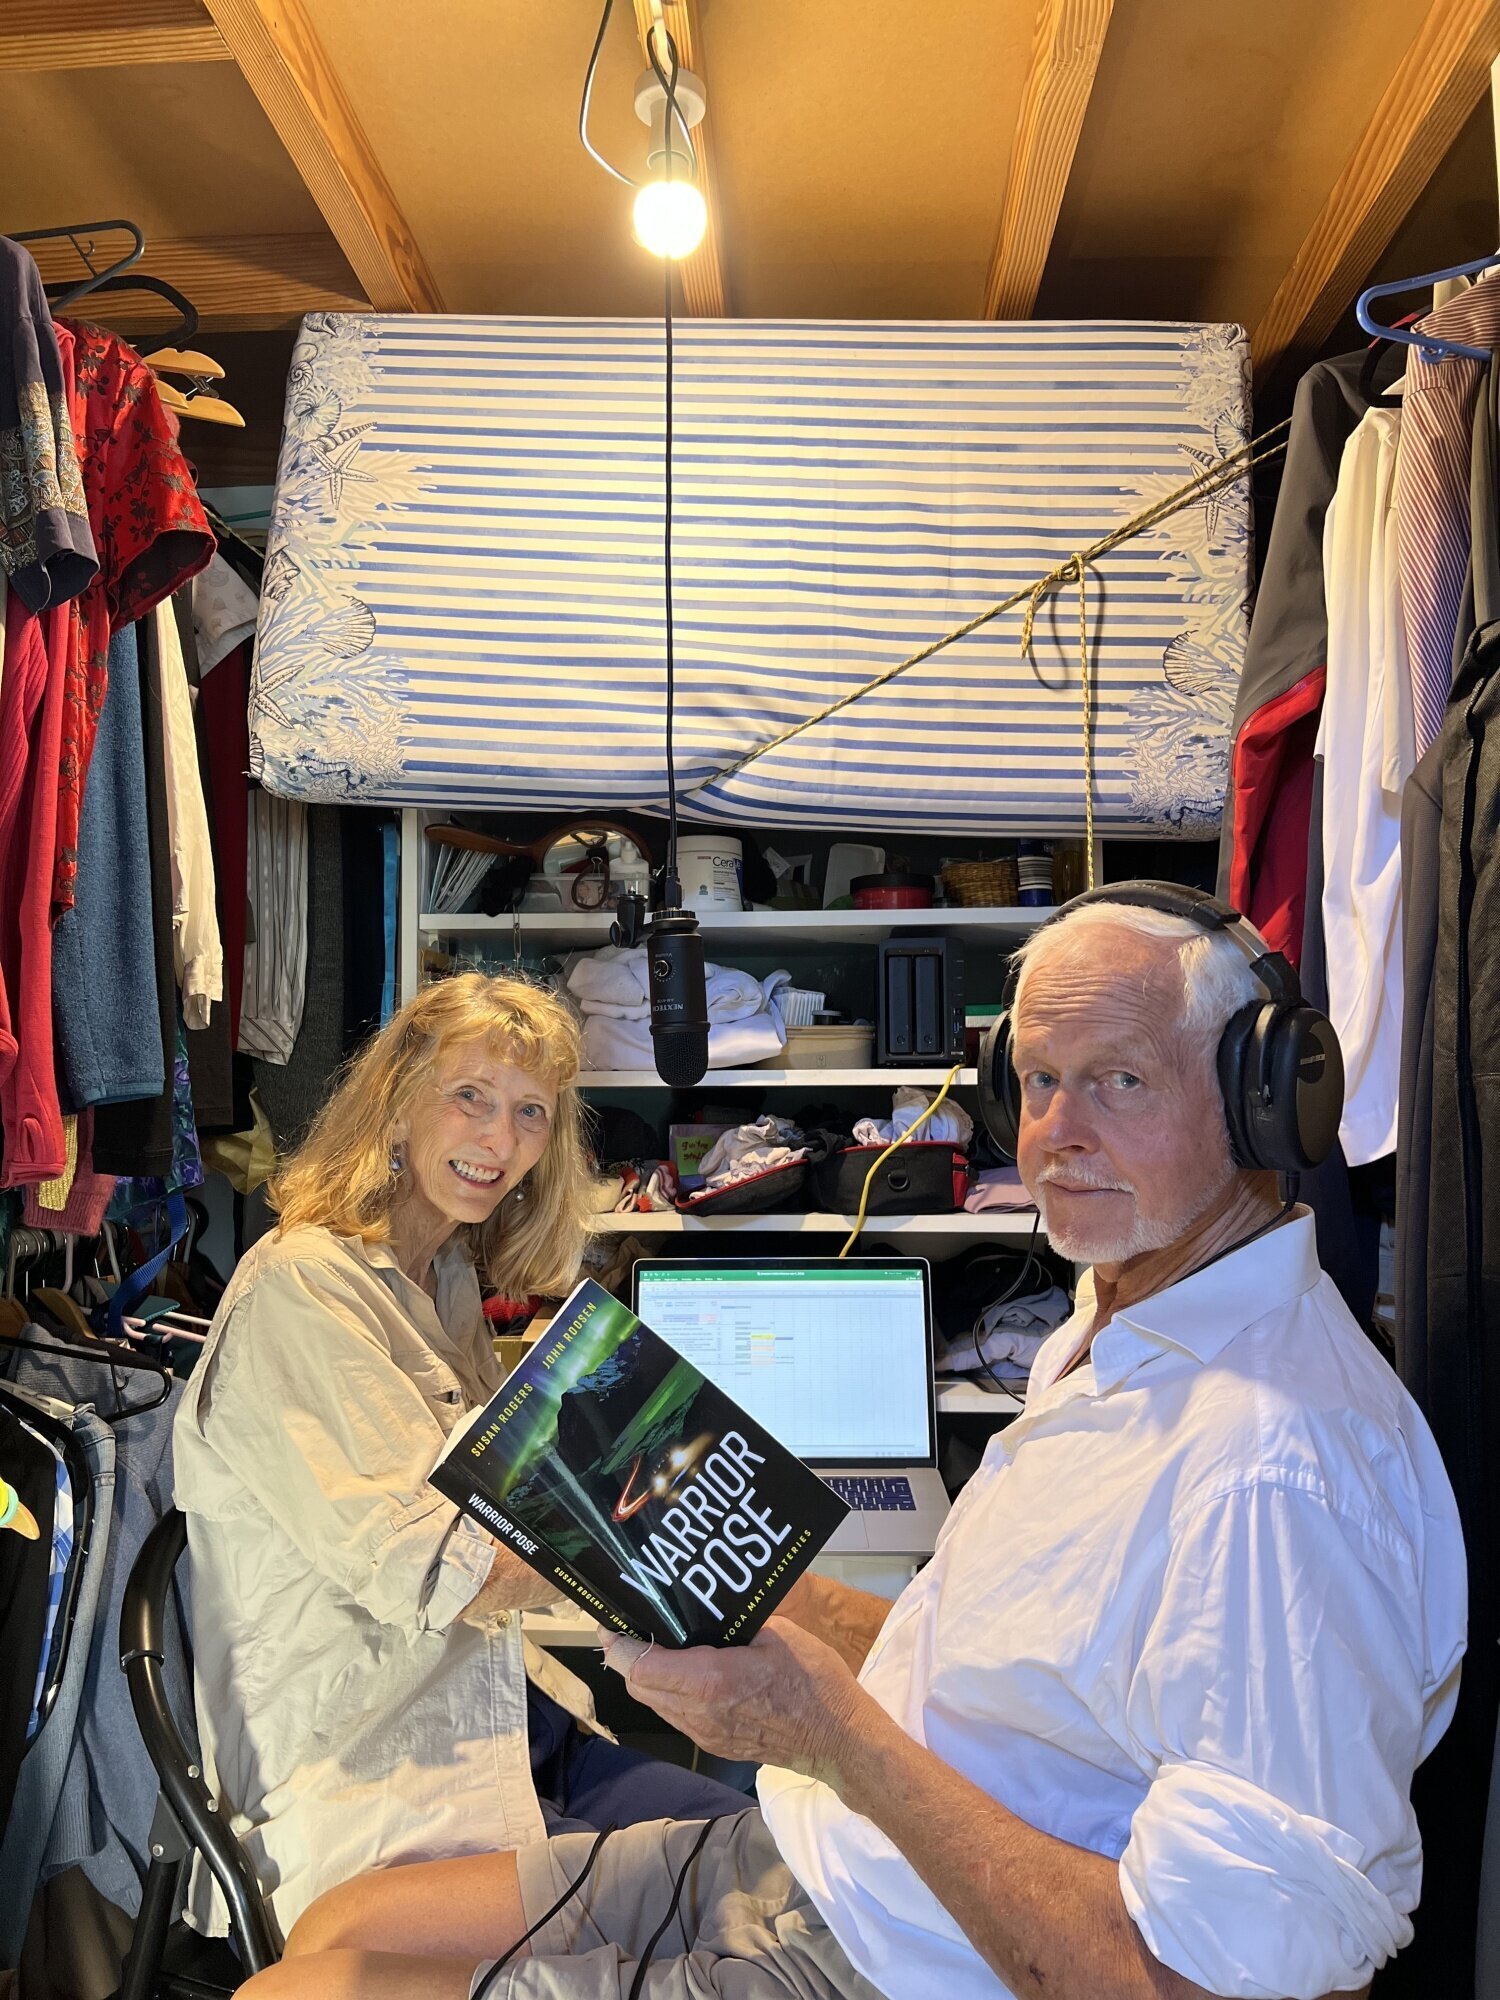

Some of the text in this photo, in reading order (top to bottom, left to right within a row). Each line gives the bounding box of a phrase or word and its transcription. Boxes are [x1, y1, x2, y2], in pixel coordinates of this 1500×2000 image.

[542, 1301, 597, 1370] JOHN ROOSEN
[471, 1382, 534, 1457] SUSAN ROGERS
[468, 1493, 540, 1555] WARRIOR POSE
[619, 1430, 766, 1601] WARRIOR
[554, 1566, 603, 1610] SUSAN ROGERS
[681, 1487, 793, 1622] POSE
[723, 1529, 812, 1642] YOGA MAT MYSTERIES
[609, 1614, 643, 1641] JOHN ROO
